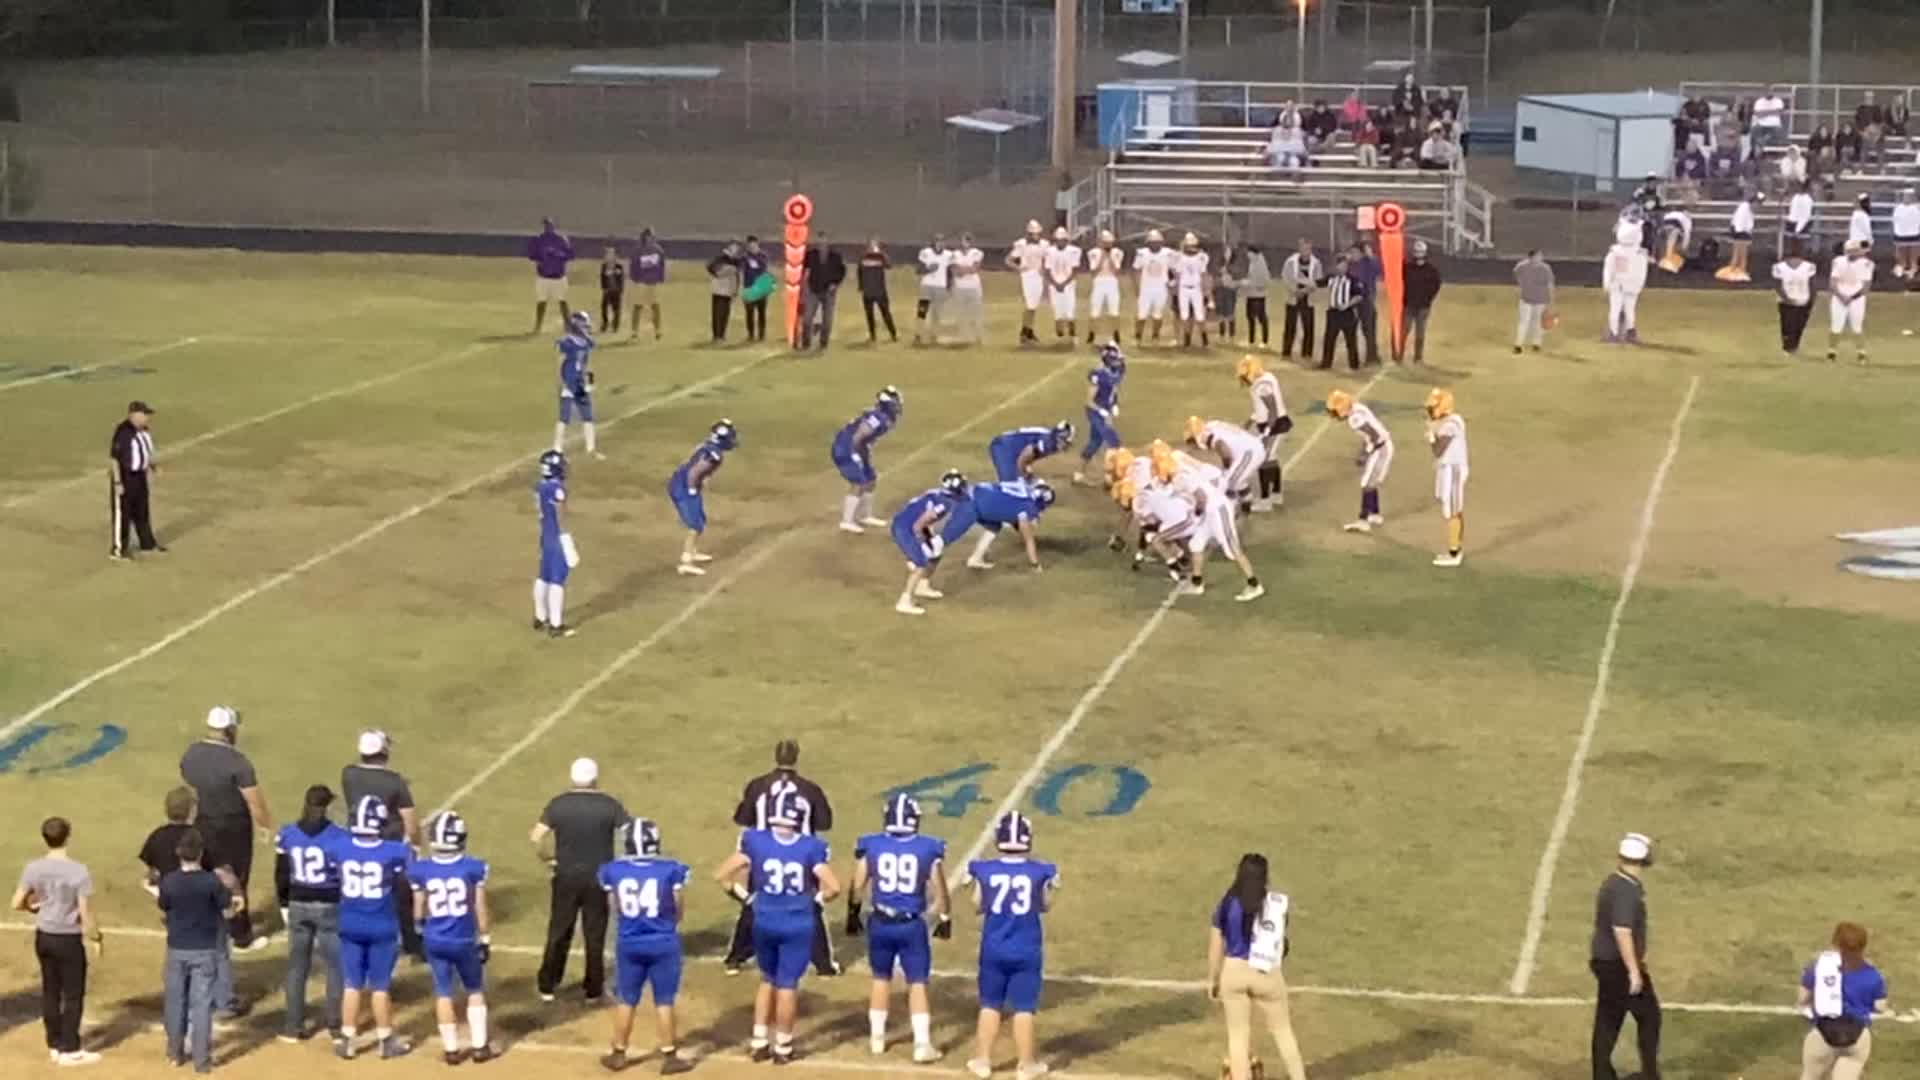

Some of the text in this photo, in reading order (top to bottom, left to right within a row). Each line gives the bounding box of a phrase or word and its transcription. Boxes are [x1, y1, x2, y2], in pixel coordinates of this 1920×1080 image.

[291, 846, 326, 883] 12
[342, 860, 383, 898] 62
[762, 858, 805, 896] 33
[876, 852, 918, 894] 99
[426, 878, 468, 917] 22
[617, 878, 660, 919] 64
[988, 873, 1032, 915] 73
